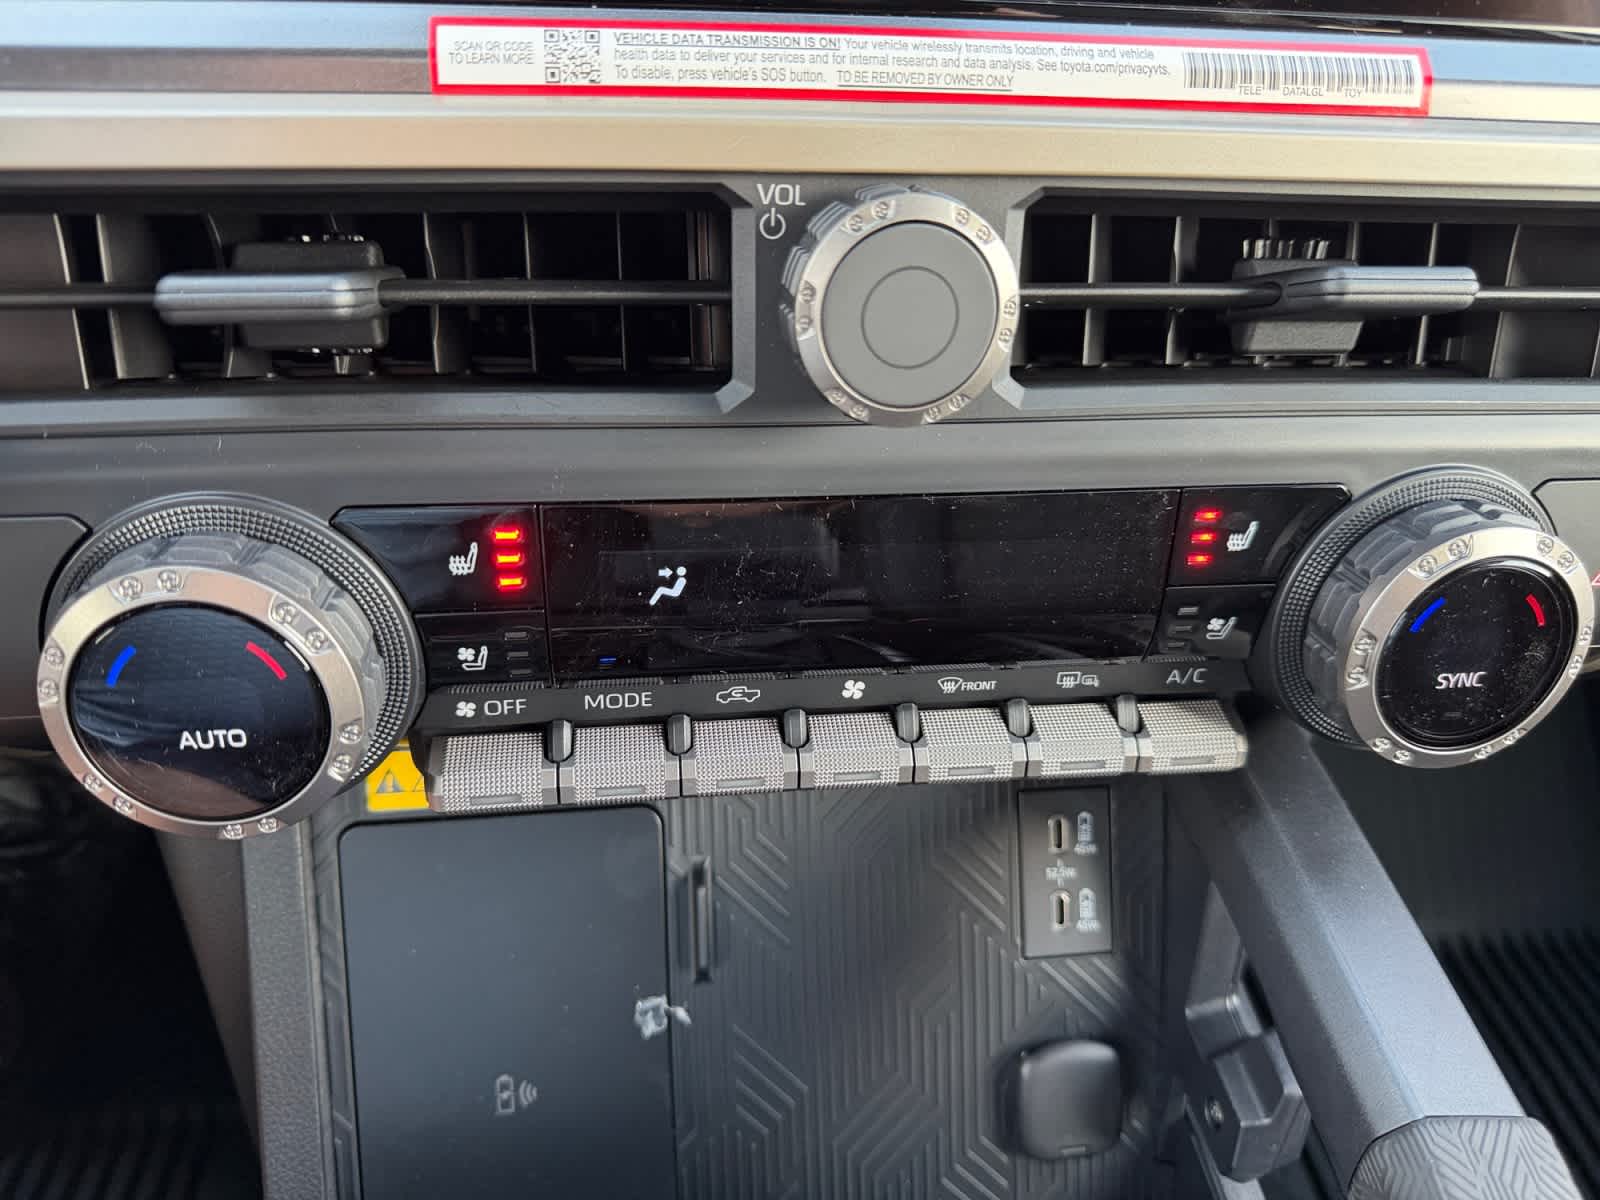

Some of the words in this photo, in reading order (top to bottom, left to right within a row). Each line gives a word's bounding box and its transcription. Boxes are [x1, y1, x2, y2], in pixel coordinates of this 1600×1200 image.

[613, 32, 670, 44] VEHICLE
[672, 33, 704, 45] DATA
[706, 34, 801, 48] TRANSMISSION
[804, 36, 816, 48] IS
[819, 36, 842, 48] ON!
[844, 37, 870, 50] Your
[871, 39, 909, 51] vehicle
[912, 40, 963, 53] wirelessly
[965, 42, 1013, 55] transmits
[1014, 43, 1058, 57] location,
[1060, 45, 1095, 60] driving
[1097, 47, 1117, 59] and
[1120, 48, 1155, 60] vehicle
[448, 52, 464, 64] TO
[466, 52, 500, 64] LEARN
[503, 52, 535, 64] MORE
[614, 48, 649, 60] health
[652, 49, 676, 61] data
[680, 50, 690, 61] to
[694, 49, 731, 62] deliver
[733, 53, 758, 65] your
[761, 51, 806, 64] services
[808, 53, 829, 65] and
[832, 53, 847, 65] for
[850, 53, 889, 66] internal
[892, 54, 938, 67] research
[941, 56, 961, 68] and
[963, 57, 986, 69] data
[989, 58, 1034, 72] analysis.
[1036, 59, 1057, 71] See
[615, 65, 629, 79] To
[631, 65, 675, 81] disable,
[678, 68, 708, 82] press
[710, 67, 758, 81] vehicle's
[761, 67, 787, 82] SOS
[790, 68, 828, 82] button.
[837, 70, 851, 83] TO
[854, 71, 870, 84] BE
[872, 71, 926, 85] REMOVED
[927, 73, 943, 85] BY
[944, 73, 984, 86] OWNER
[985, 74, 1015, 87] ONLY
[1238, 86, 1263, 96] TELE
[1343, 88, 1363, 98] TOY
[756, 183, 806, 206] VOL
[960, 679, 998, 692] FRONT
[1166, 667, 1208, 685] A/C
[1435, 671, 1488, 689] SYNC
[483, 698, 528, 717] OFF
[584, 691, 653, 711] MODE
[178, 728, 248, 750] AUTO
